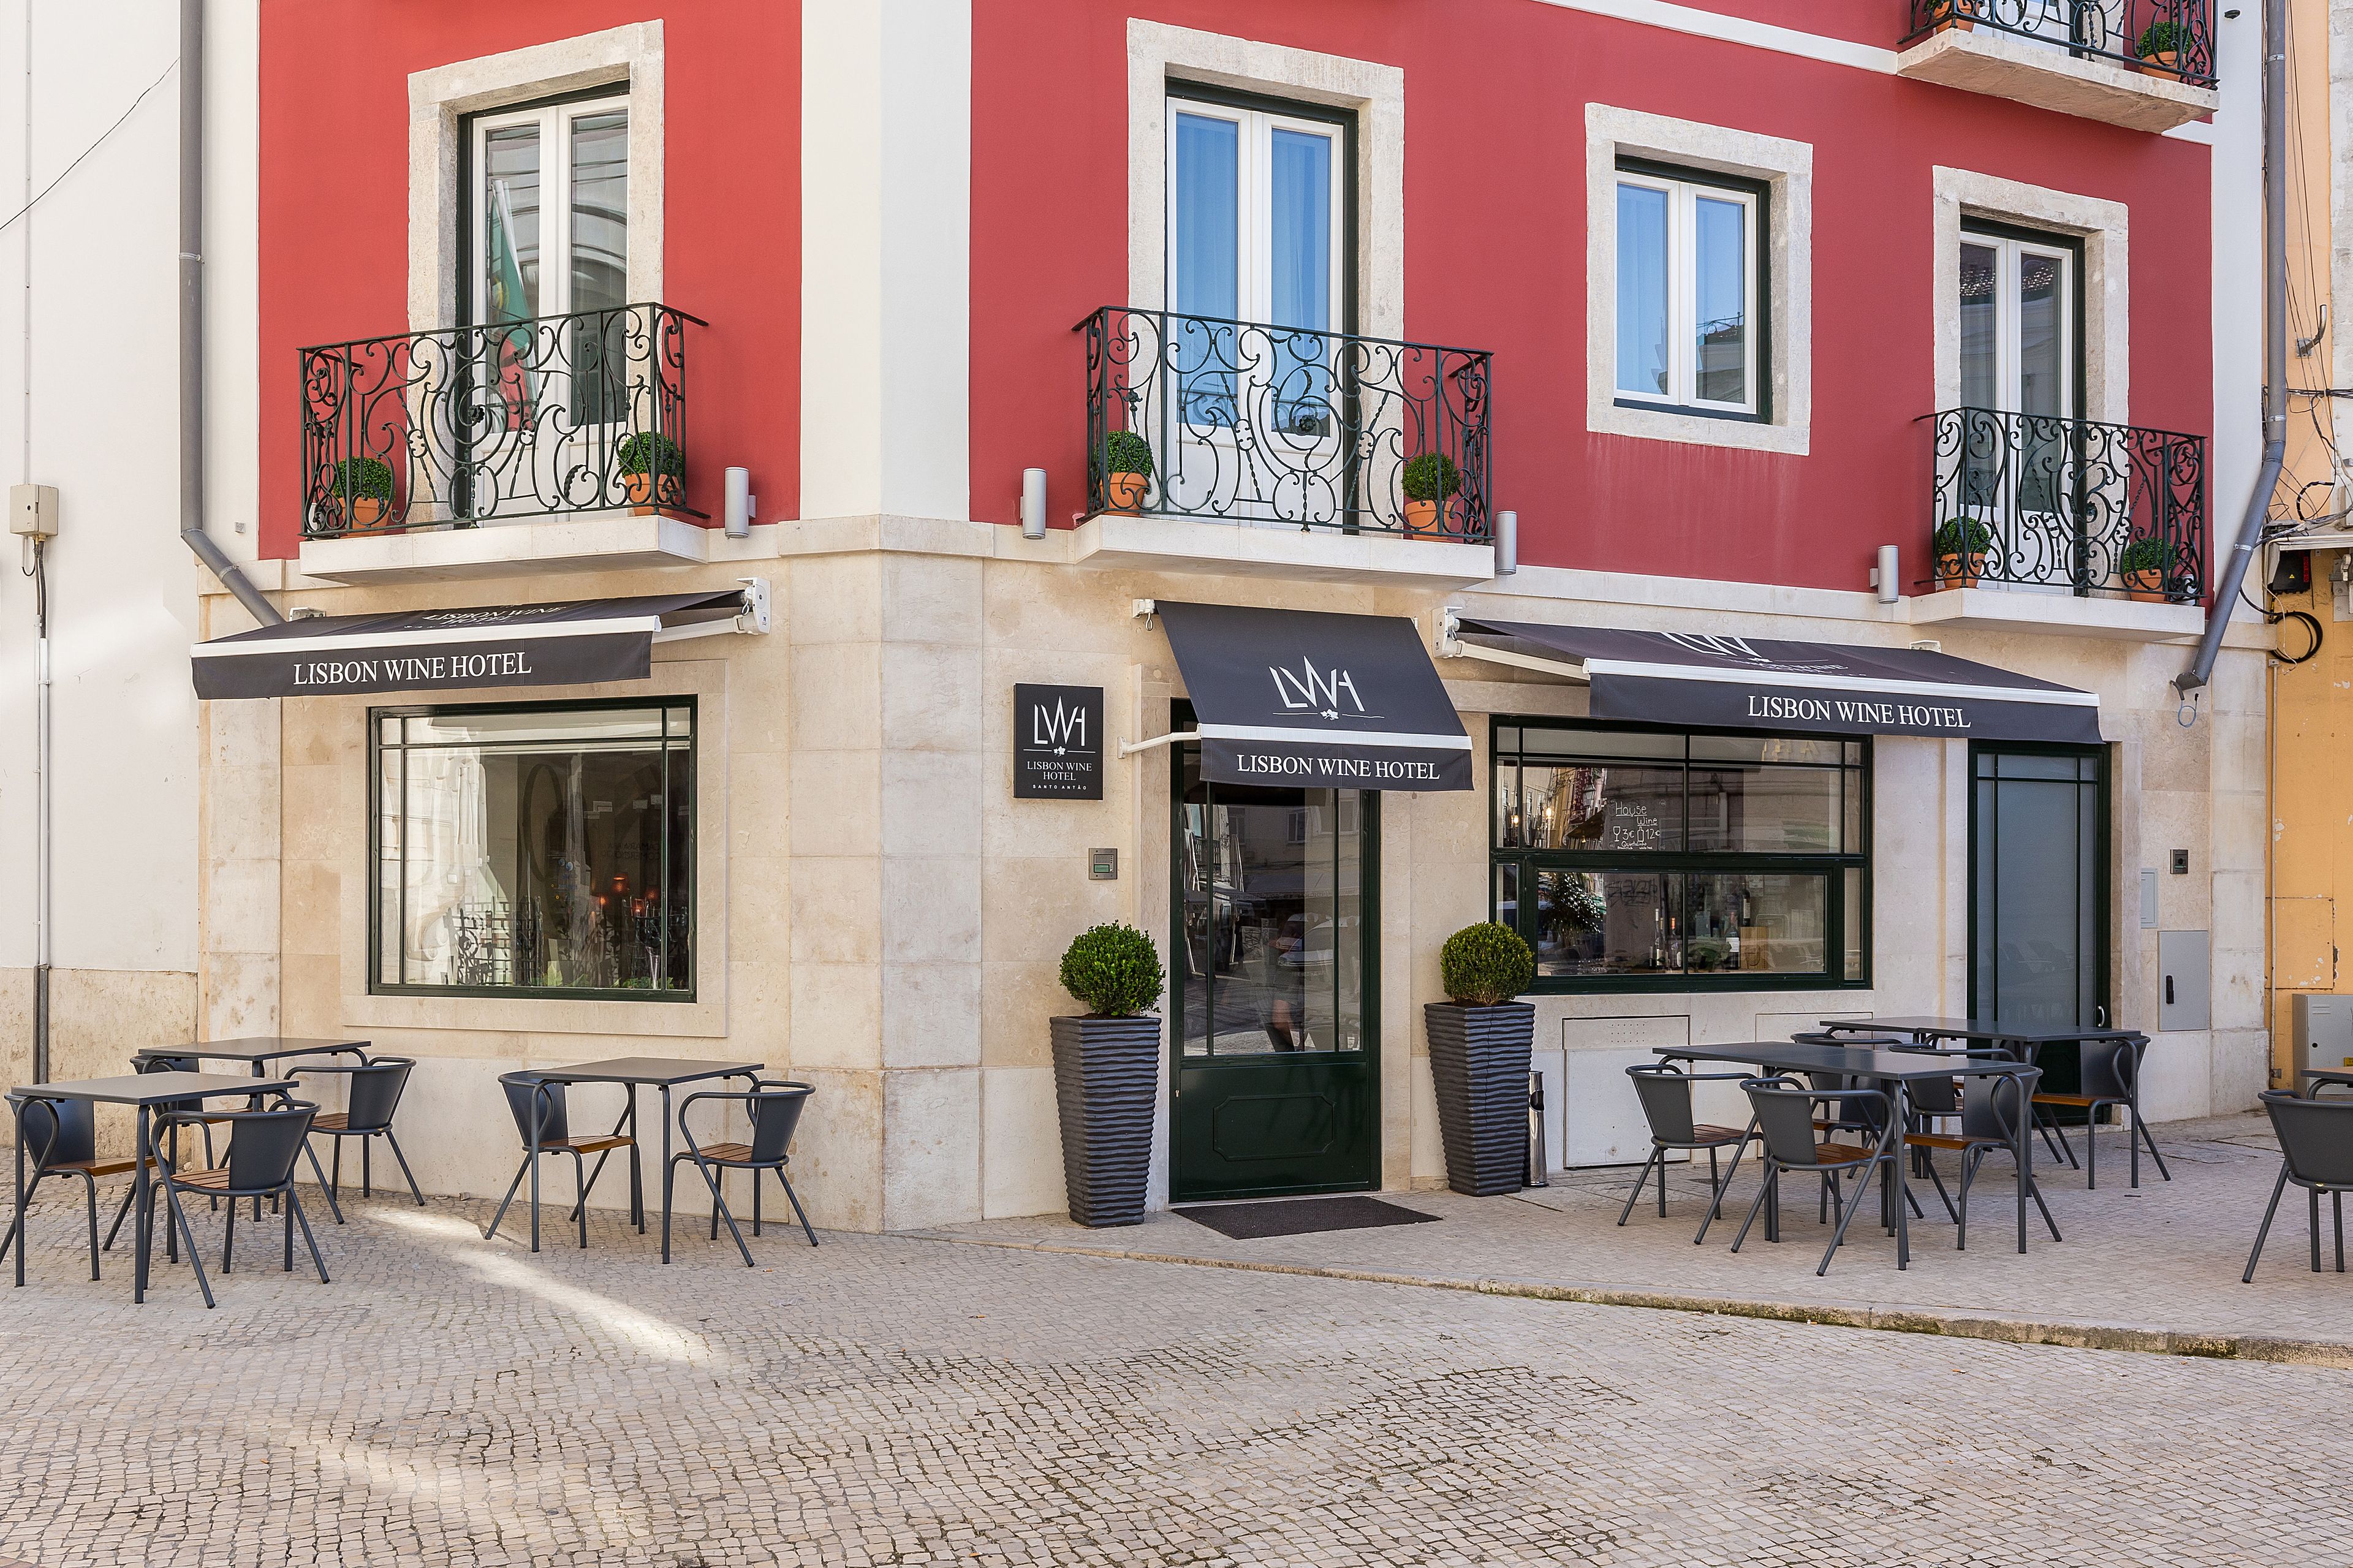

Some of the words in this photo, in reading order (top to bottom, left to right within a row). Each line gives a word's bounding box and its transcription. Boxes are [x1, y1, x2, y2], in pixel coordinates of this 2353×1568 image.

[293, 660, 379, 685] LISBON
[382, 657, 446, 682] WINE
[450, 651, 532, 678] HOTEL
[1747, 695, 1831, 721] LISBON
[1835, 701, 1895, 724] WINE
[1897, 705, 1971, 728] HOTEL
[1027, 761, 1064, 770] LISBON
[1066, 762, 1092, 771] WINE
[1237, 754, 1314, 775] LISBON
[1317, 758, 1372, 778] WINE
[1374, 761, 1441, 780] HOTEL
[1043, 771, 1076, 781] HOTEL
[1615, 801, 1647, 815] House
[1637, 816, 1658, 825] Wine
[1622, 829, 1634, 840] 3€
[1645, 828, 1660, 839] 12€
